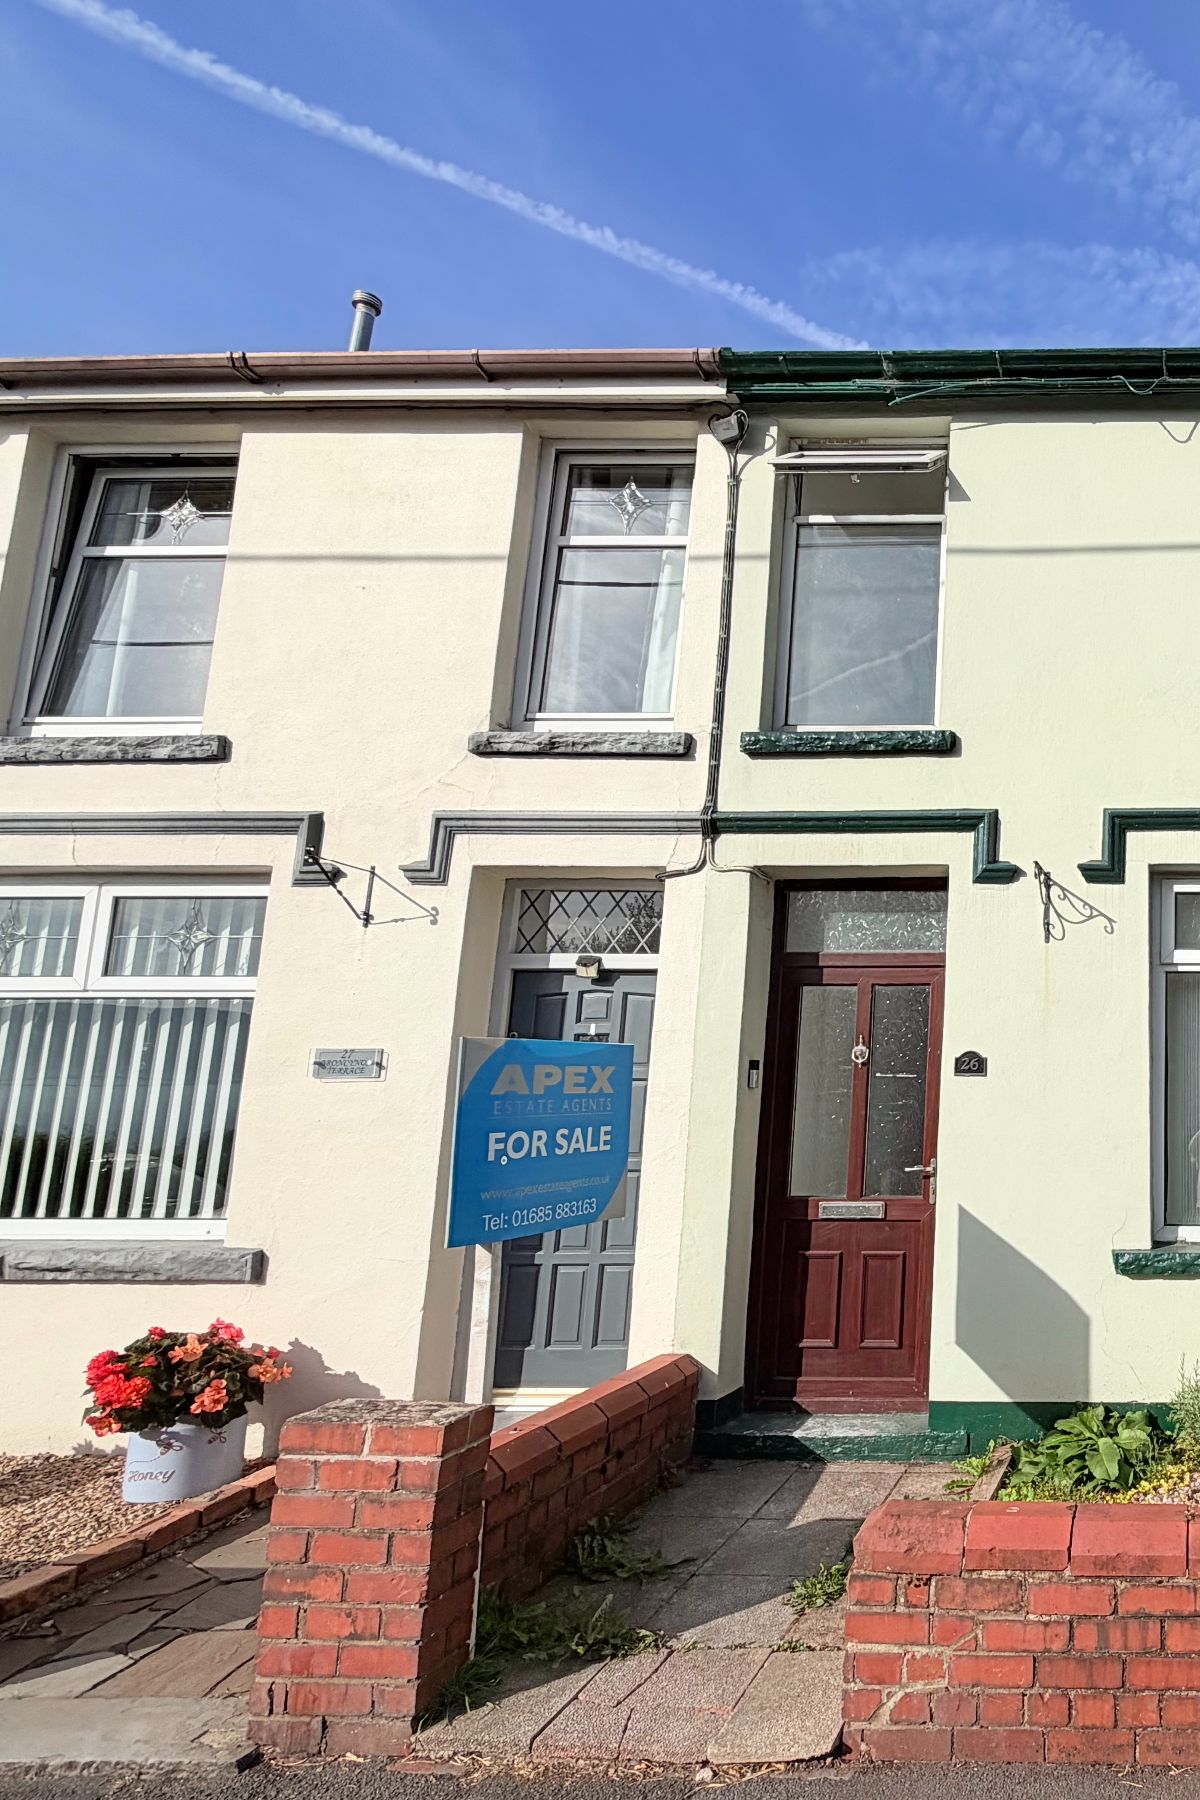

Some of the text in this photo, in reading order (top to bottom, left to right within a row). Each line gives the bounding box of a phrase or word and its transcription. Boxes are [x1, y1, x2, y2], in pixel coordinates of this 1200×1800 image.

[341, 1049, 355, 1059] 27
[327, 1067, 366, 1075] TERRACE
[961, 1057, 979, 1070] 26
[490, 1064, 616, 1095] APEX
[493, 1098, 612, 1115] ESTATE AGENTS
[488, 1125, 612, 1161] FOR SALE
[482, 1198, 597, 1231] Tel: 01685 883163
[128, 1469, 176, 1483] Honey
